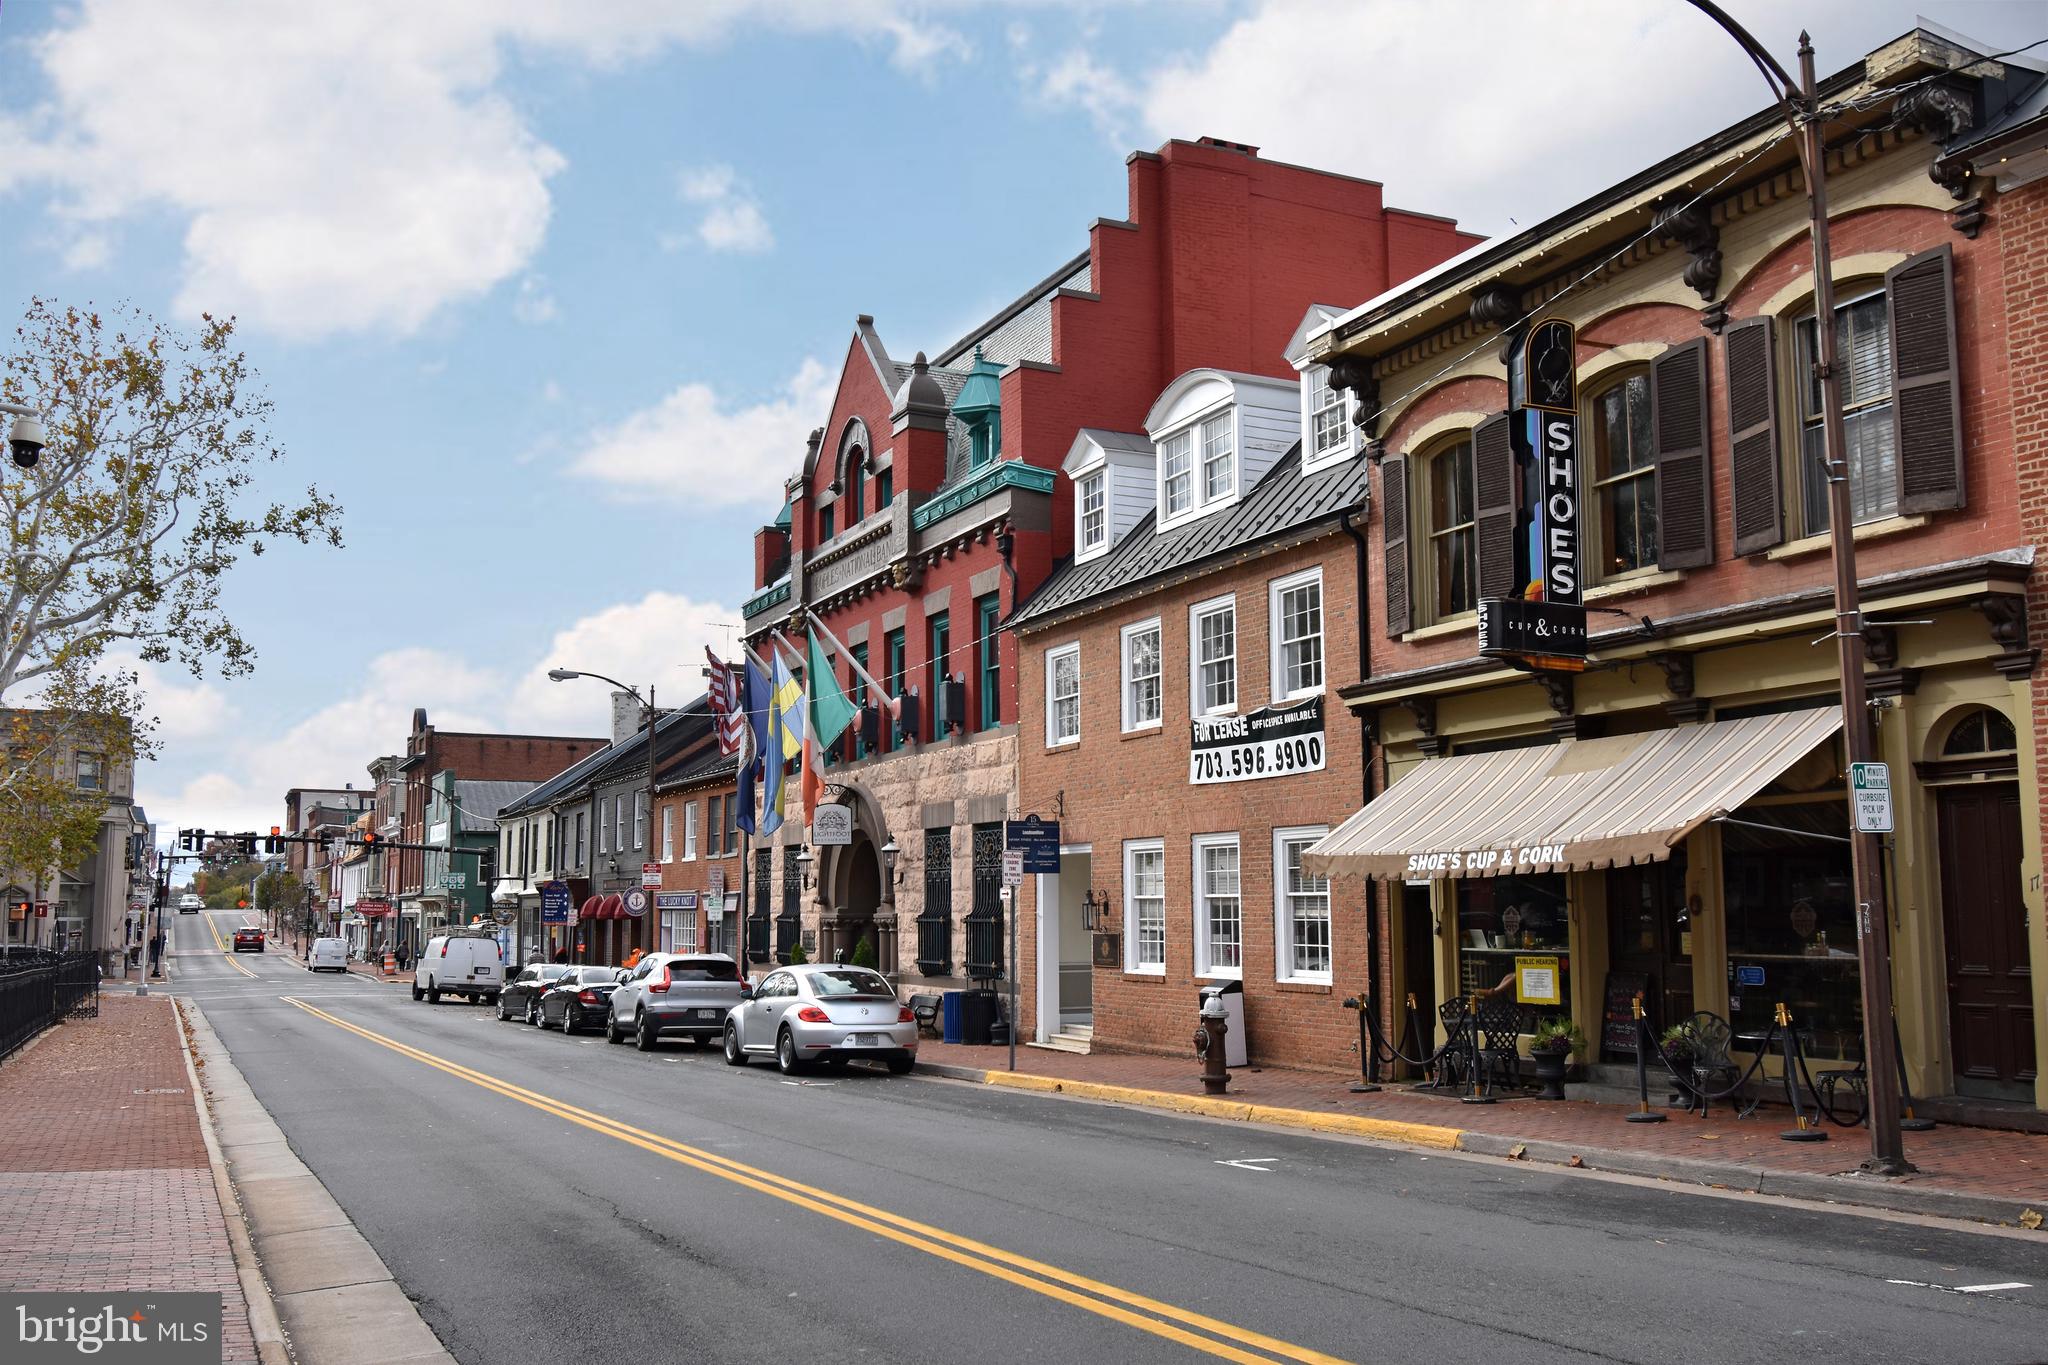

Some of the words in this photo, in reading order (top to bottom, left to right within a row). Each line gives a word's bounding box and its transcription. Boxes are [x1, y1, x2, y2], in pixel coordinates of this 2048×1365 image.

[1548, 421, 1575, 595] SHOES
[1509, 620, 1532, 631] CUP
[1535, 618, 1551, 636] &
[1553, 625, 1585, 636] CORK
[1193, 722, 1210, 743] FOR
[1213, 716, 1249, 740] LEASE
[1284, 709, 1318, 724] AVAILABLE
[1194, 736, 1321, 781] 703.596.9900
[1853, 768, 1865, 786] 10
[1867, 767, 1884, 777] MINUTE
[1867, 778, 1887, 787] PARKING
[1859, 793, 1886, 802] CURBSIDE
[1863, 804, 1876, 814] PICK
[1877, 804, 1885, 814] UP
[1030, 815, 1037, 823] 15
[1867, 816, 1882, 826] ONLY
[1408, 853, 1462, 871] SHOE'S
[1466, 851, 1498, 869] CUP
[1500, 850, 1513, 866] &
[1518, 844, 1566, 864] CORK
[681, 896, 692, 906] KNOT
